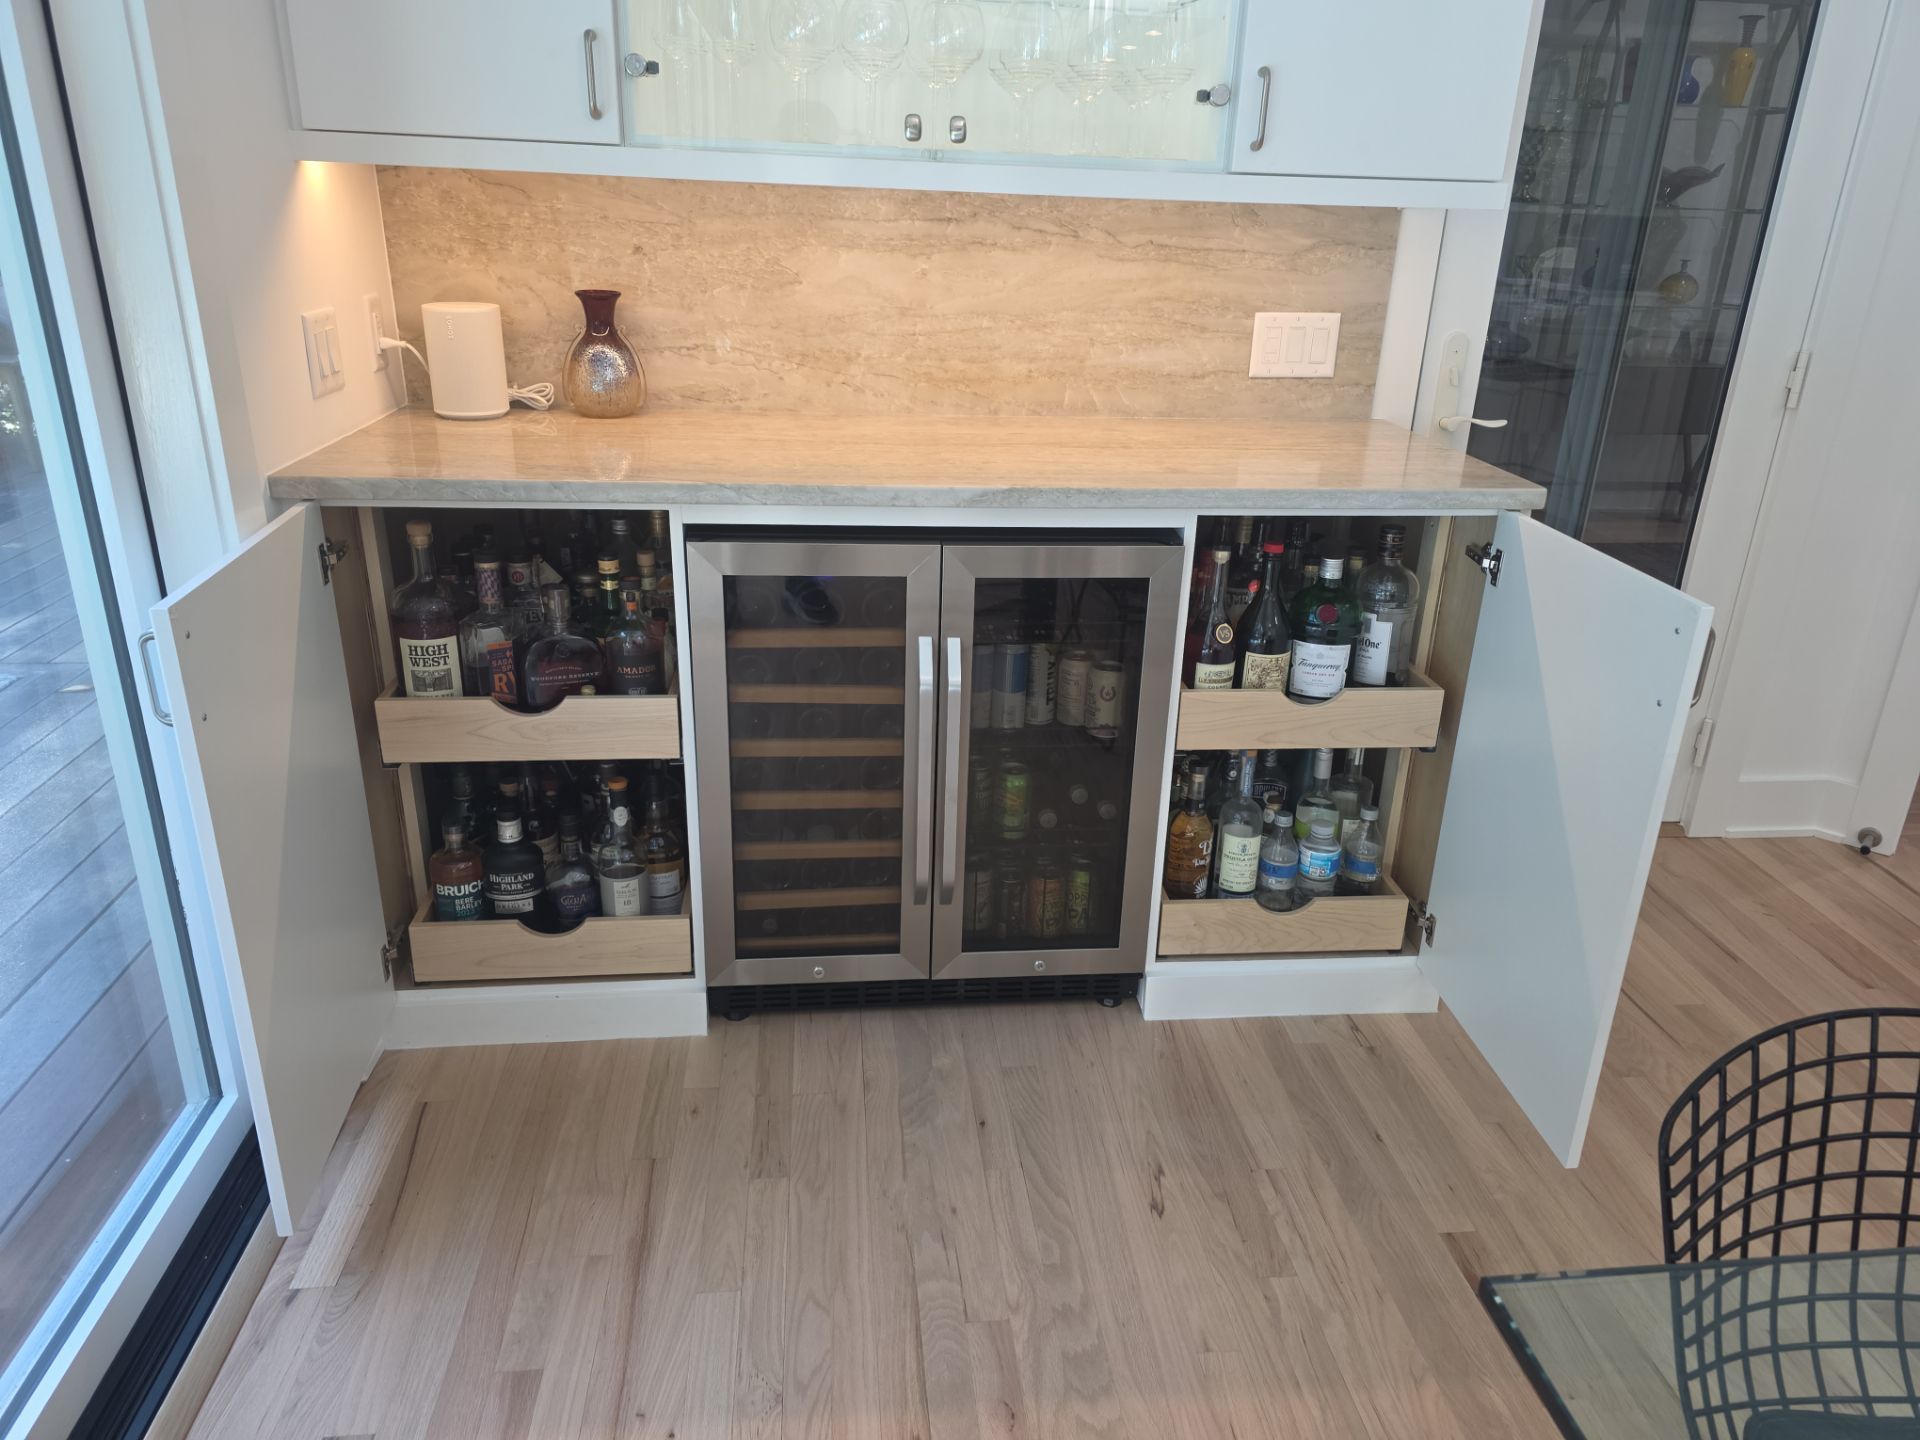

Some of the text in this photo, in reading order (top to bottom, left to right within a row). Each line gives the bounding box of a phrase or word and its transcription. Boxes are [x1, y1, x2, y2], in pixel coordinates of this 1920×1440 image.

[447, 315, 455, 341] SONOS
[407, 643, 449, 658] HIGH
[408, 656, 450, 668] WEST
[489, 873, 534, 883] HIGHLAND
[501, 882, 524, 891] PARK
